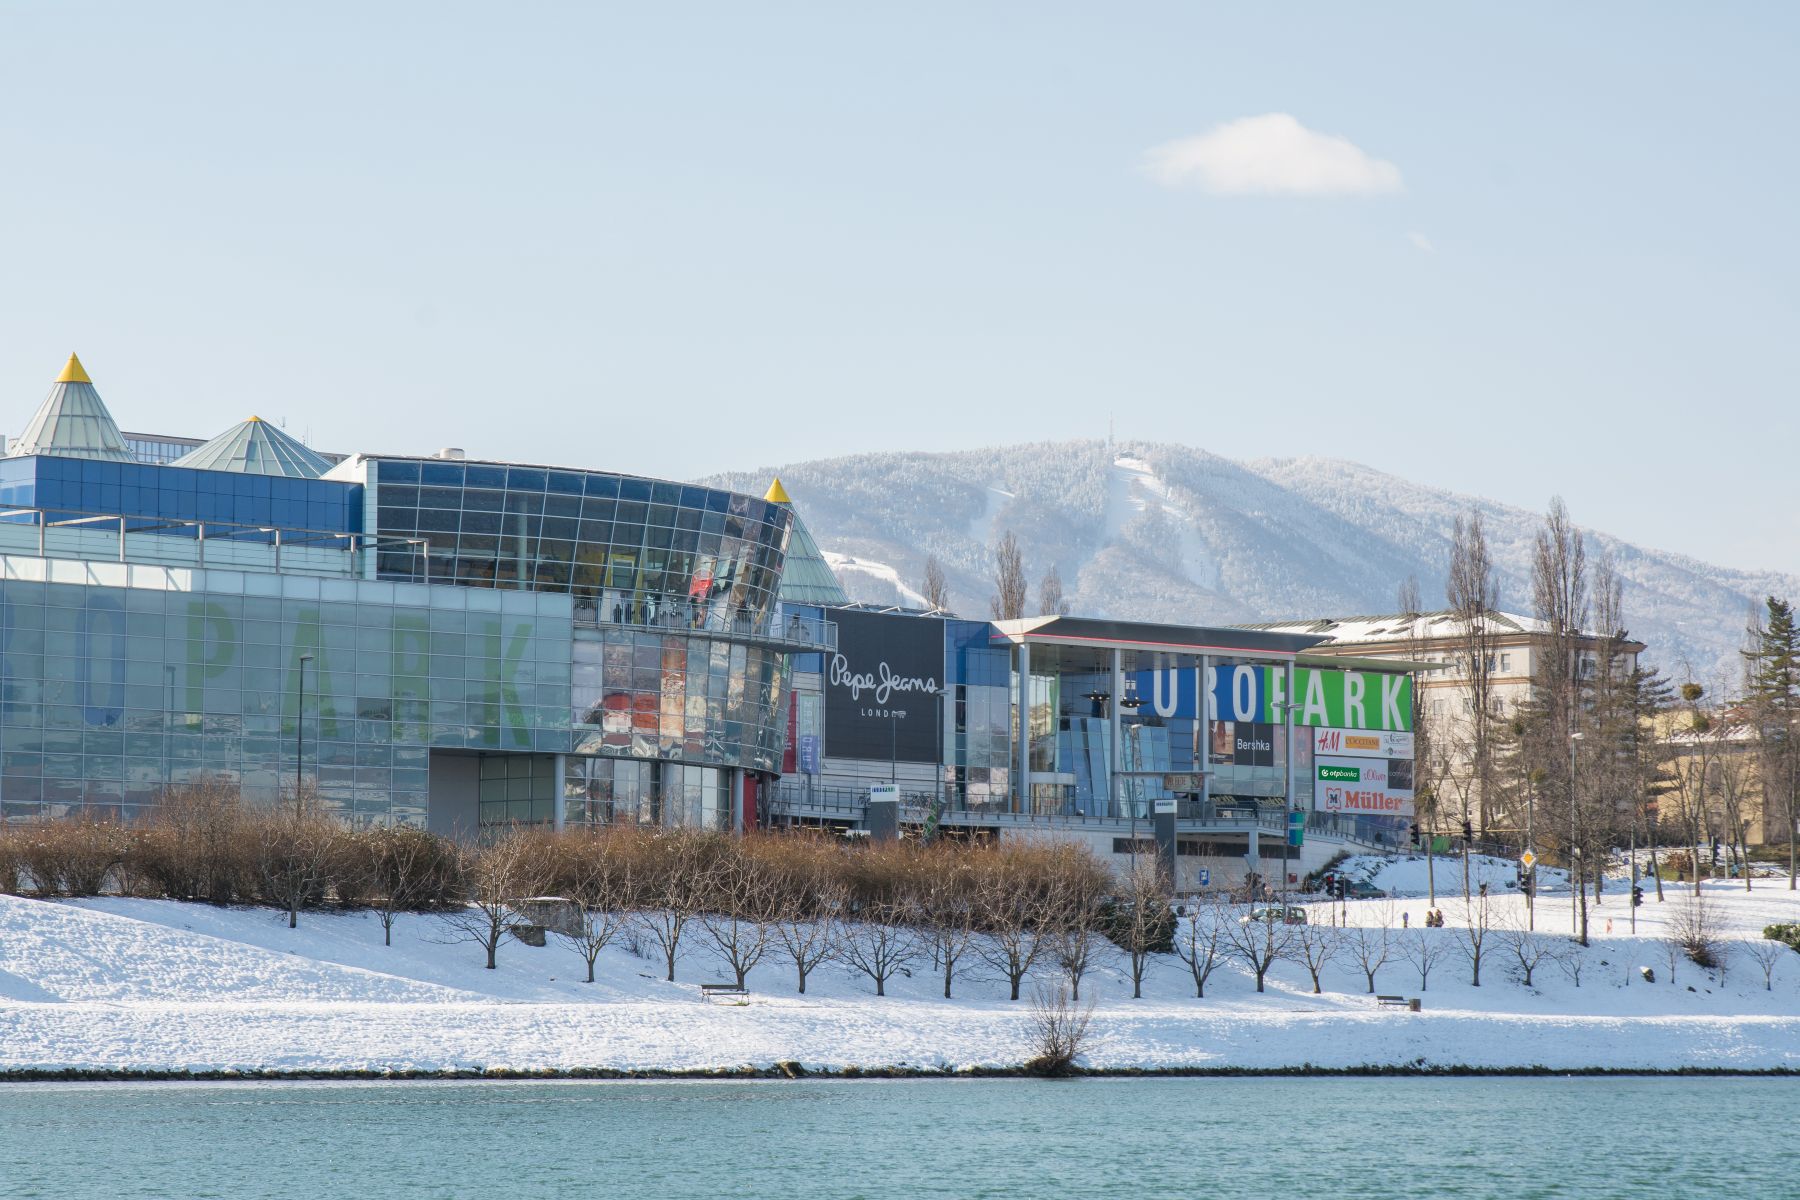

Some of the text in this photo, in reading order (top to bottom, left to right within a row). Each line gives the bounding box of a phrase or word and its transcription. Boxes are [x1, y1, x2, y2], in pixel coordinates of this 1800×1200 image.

[830, 653, 938, 704] Pepe Jeans
[1236, 738, 1271, 752] Bershka
[1317, 731, 1341, 753] H&M
[1344, 790, 1402, 811] Müller
